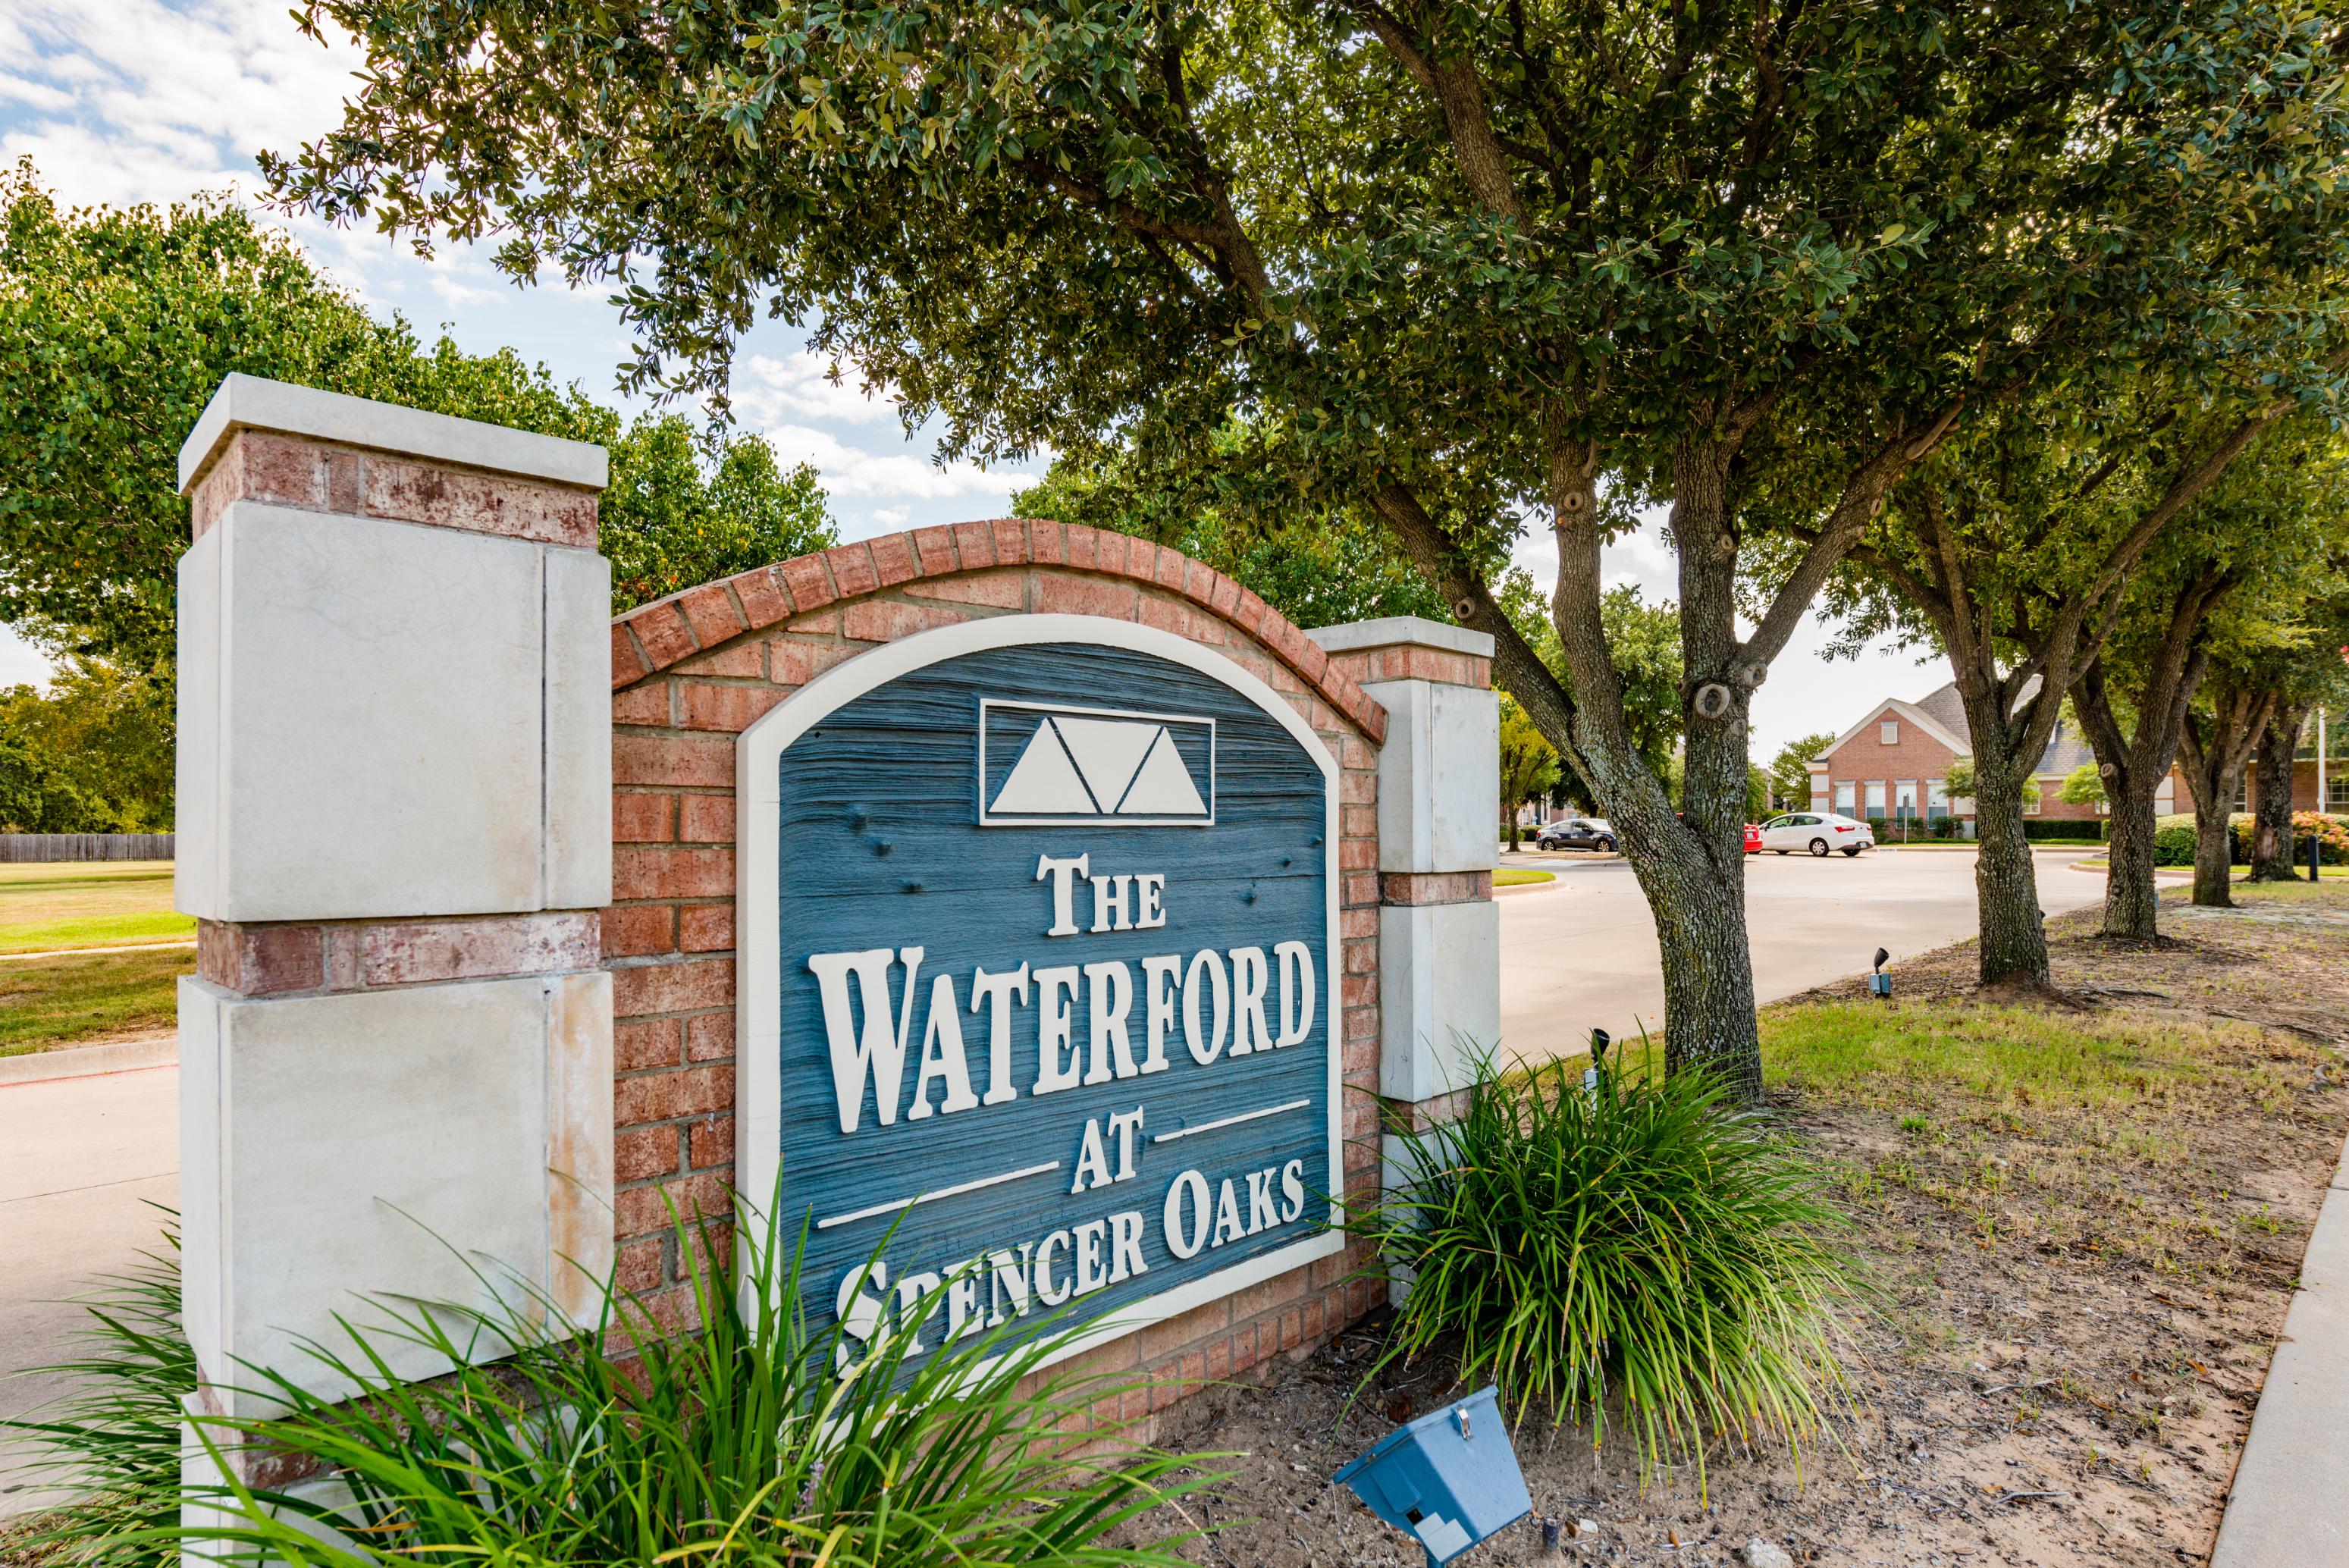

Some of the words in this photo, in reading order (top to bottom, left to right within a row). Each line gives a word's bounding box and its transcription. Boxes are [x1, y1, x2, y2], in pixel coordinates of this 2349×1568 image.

[1037, 853, 1166, 936] THE
[808, 940, 1316, 1134] WATERFORD
[1071, 1105, 1143, 1194] AT
[836, 1211, 1149, 1380] SPENCER
[1163, 1159, 1304, 1259] OAKS
